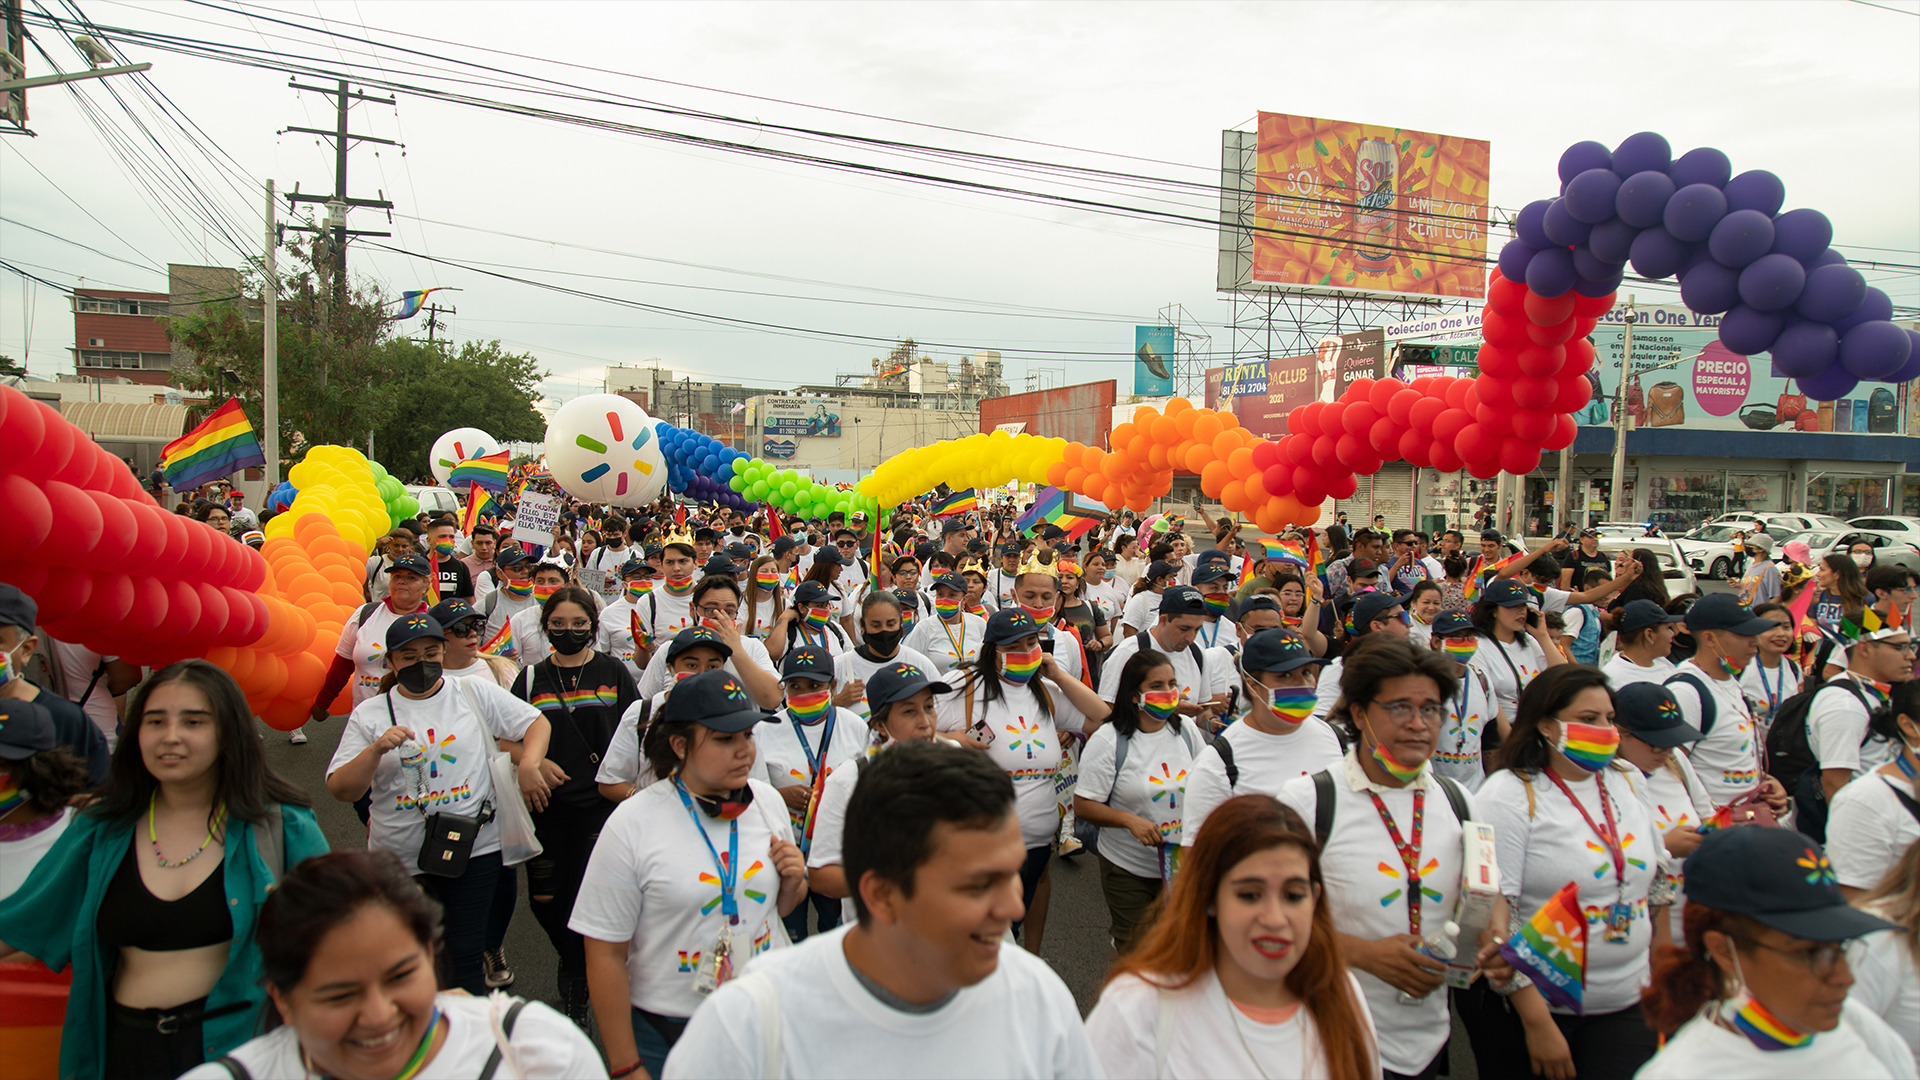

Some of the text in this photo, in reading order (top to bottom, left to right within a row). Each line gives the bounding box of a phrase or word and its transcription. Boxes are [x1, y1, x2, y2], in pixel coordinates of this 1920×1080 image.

[1290, 162, 1318, 172] NUEVA
[1287, 170, 1321, 196] SOL
[1358, 158, 1394, 196] SOL
[1266, 193, 1343, 218] MEZCLAS
[1408, 197, 1417, 208] LA
[1277, 215, 1330, 230] MANGOYADA
[1408, 216, 1478, 241] PERFECTA
[1654, 309, 1687, 325] One
[1691, 311, 1722, 326] Ven
[1387, 321, 1437, 336] Coleccion
[1440, 318, 1462, 329] One
[1617, 334, 1657, 342] Ctamos
[1639, 344, 1682, 352] Nacionales
[1619, 352, 1656, 361] calquier
[1343, 357, 1375, 370] ¿Quieres
[1697, 360, 1747, 375] PRECIO
[1224, 363, 1267, 382] RENTA
[1267, 368, 1308, 387] DACLUB
[1343, 369, 1375, 382] GANAR
[1696, 375, 1746, 386] ESPECIAL A
[1247, 382, 1267, 393] 2704
[1696, 386, 1746, 396] MAYORISTAS
[1269, 394, 1284, 404] 2021
[522, 500, 532, 508] ME
[521, 507, 556, 520] ELLOS BTS
[518, 520, 535, 530] ELLAS
[579, 571, 589, 581] KE
[1817, 602, 1842, 621] PRI
[1006, 768, 1041, 780] 00%
[451, 778, 471, 800] TÚ
